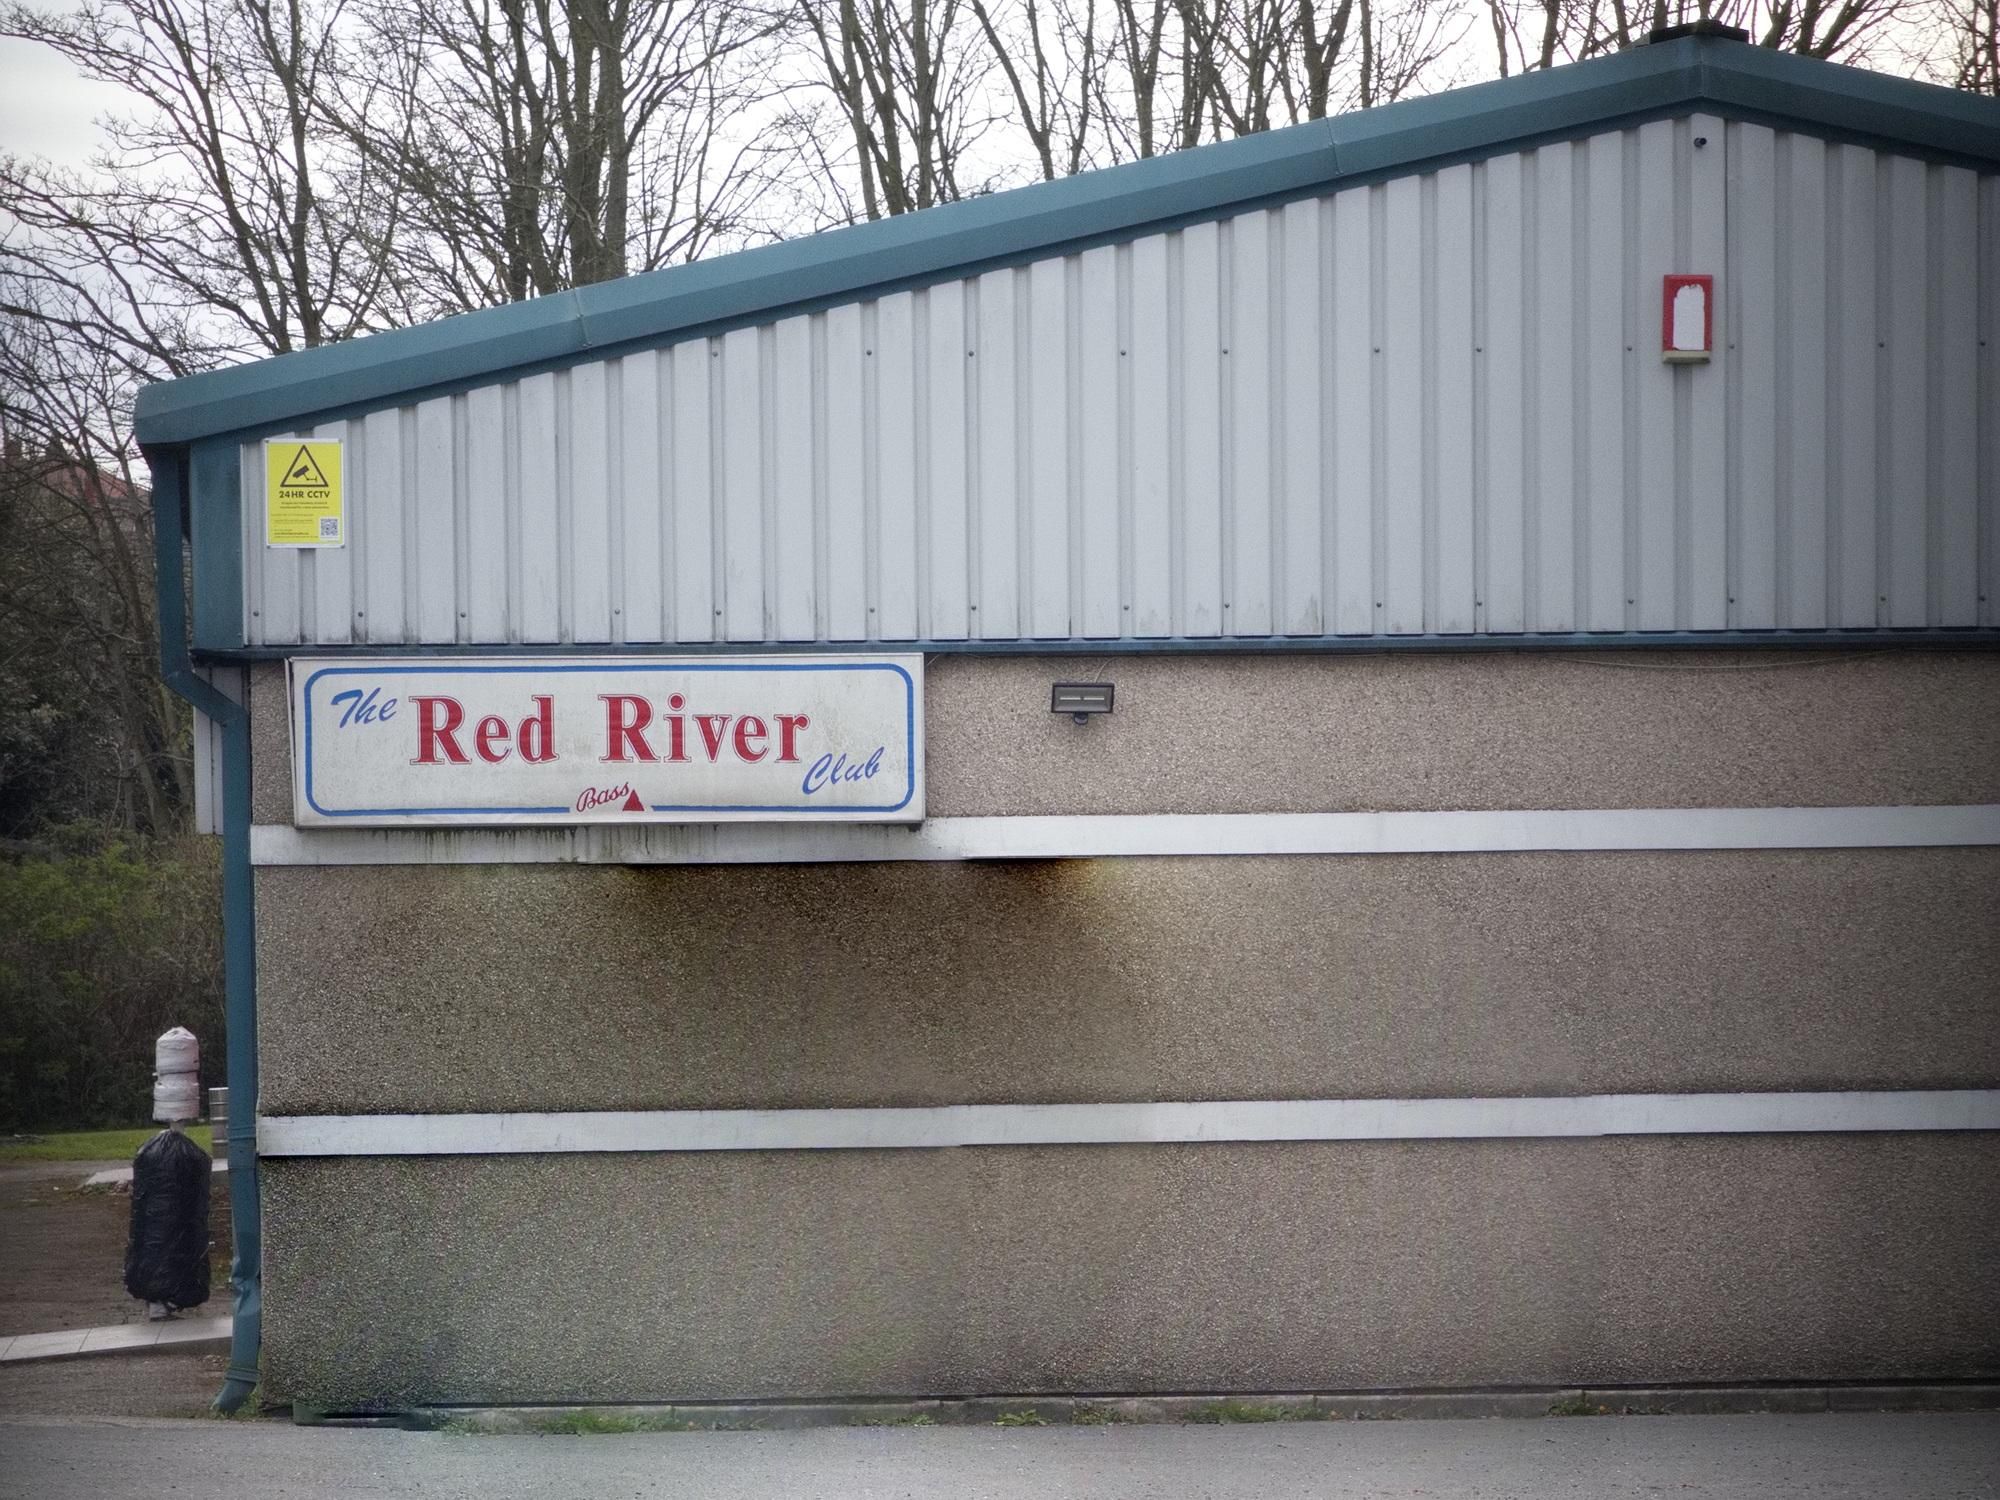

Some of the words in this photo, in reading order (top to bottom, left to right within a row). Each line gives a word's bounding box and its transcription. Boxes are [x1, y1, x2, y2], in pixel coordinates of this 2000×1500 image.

[307, 490, 330, 498] CCTV
[331, 687, 398, 728] The
[408, 695, 559, 765] Red
[598, 693, 811, 763] River
[803, 746, 883, 795] Club
[577, 782, 630, 812] Bass
